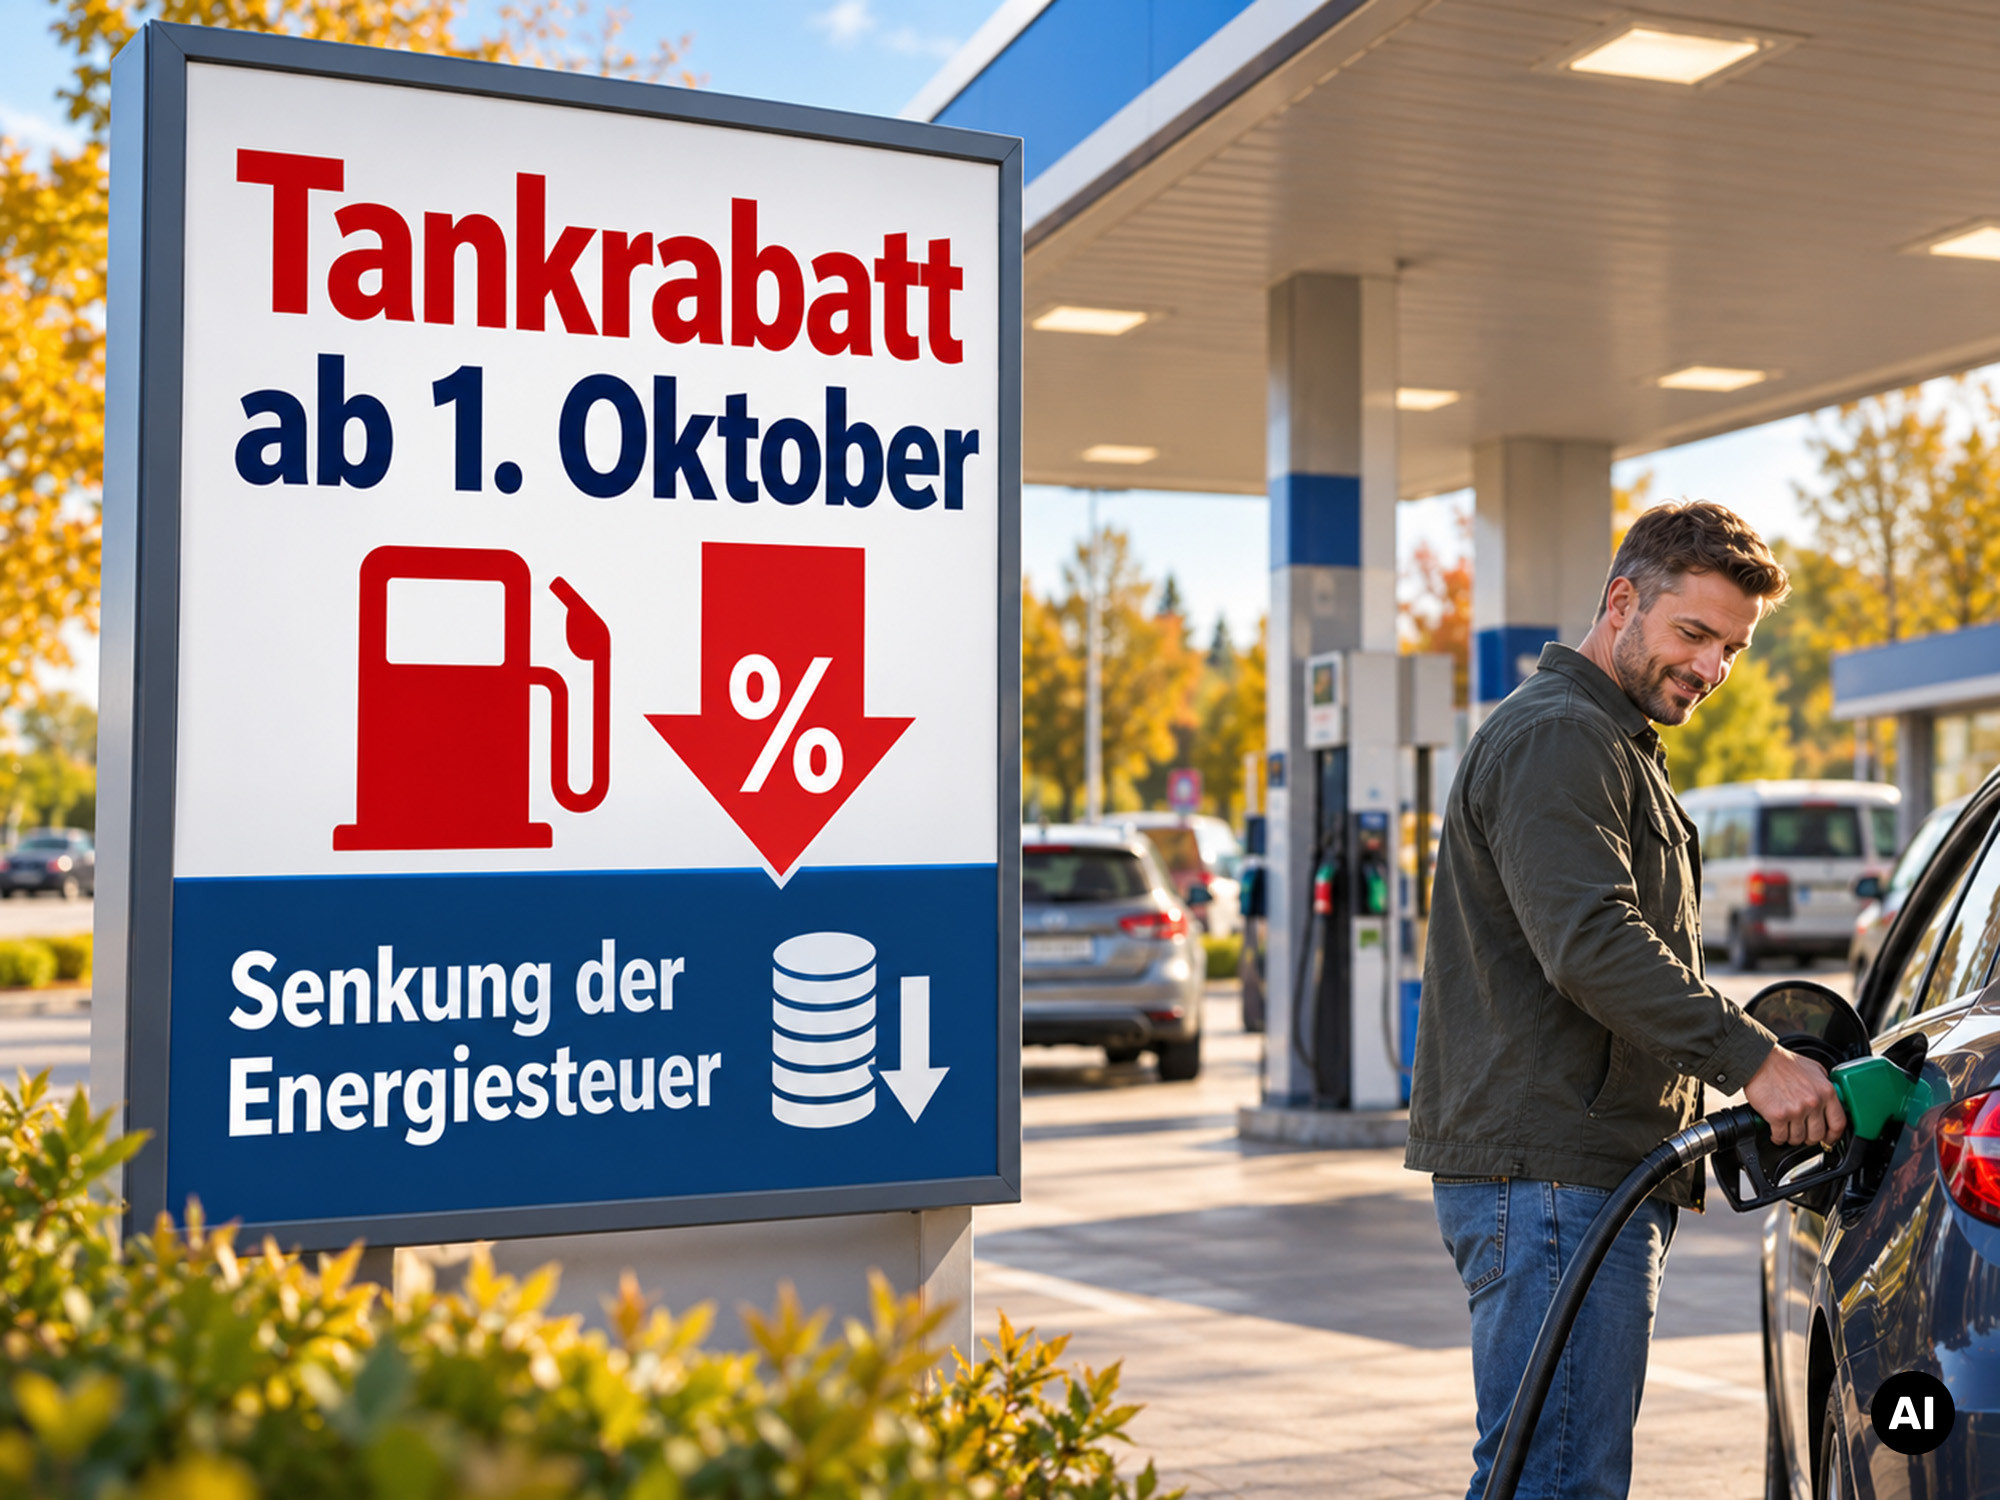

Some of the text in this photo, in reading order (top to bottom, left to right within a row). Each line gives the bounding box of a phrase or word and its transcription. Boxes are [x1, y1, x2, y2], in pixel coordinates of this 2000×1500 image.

[236, 148, 964, 364] Tankrabatt
[235, 353, 980, 511] ab 1. Oktober
[729, 652, 845, 795] %
[228, 938, 686, 1037] Senkung der
[228, 1044, 722, 1146] Energiesteuer
